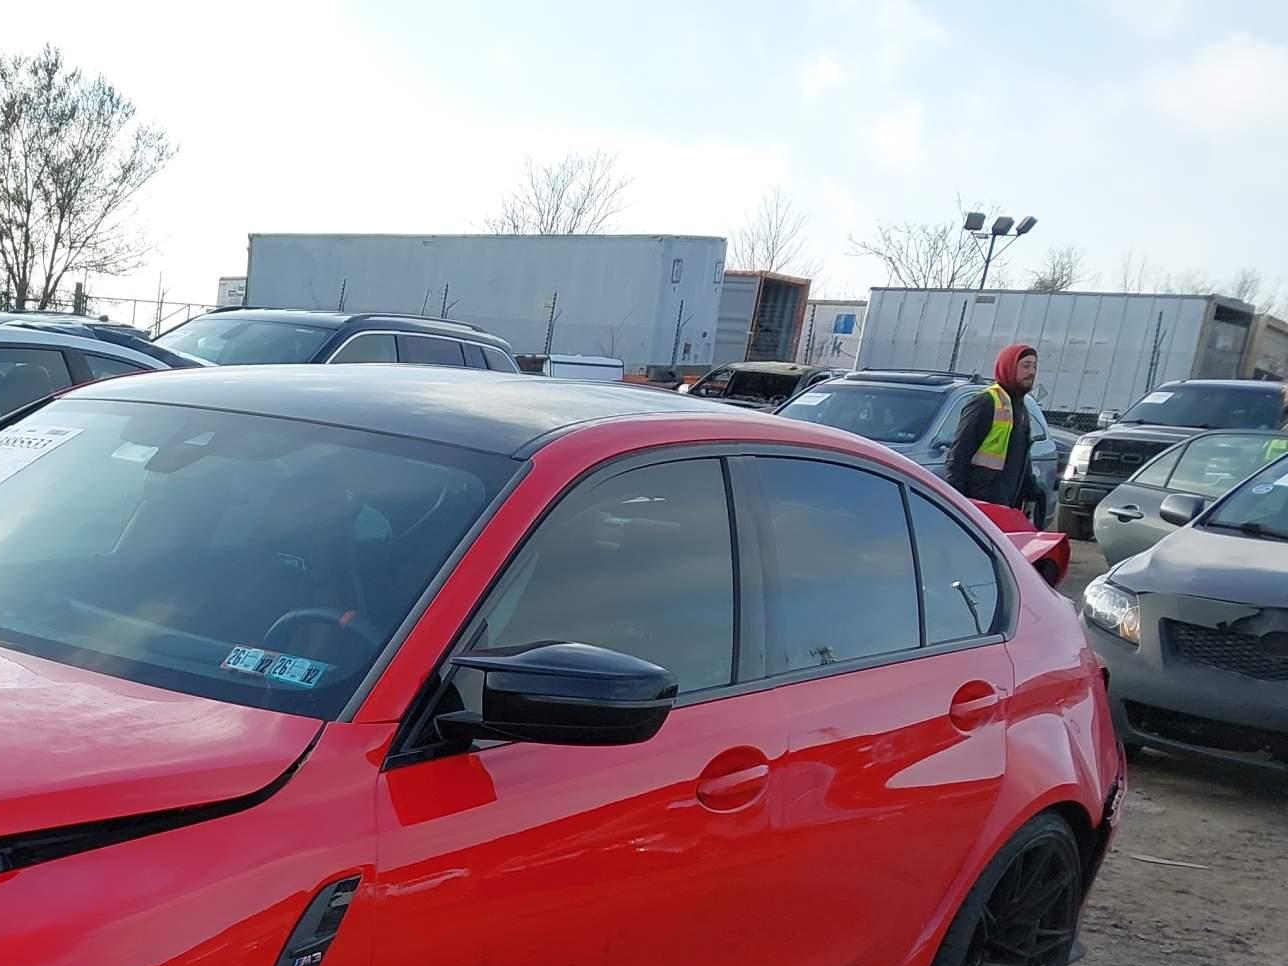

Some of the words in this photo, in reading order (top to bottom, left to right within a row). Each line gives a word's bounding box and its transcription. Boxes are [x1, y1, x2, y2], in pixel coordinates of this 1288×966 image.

[1094, 450, 1149, 464] FO
[227, 648, 246, 666] 26
[255, 659, 273, 674] 12
[272, 657, 292, 676] 26
[302, 667, 320, 684] 12
